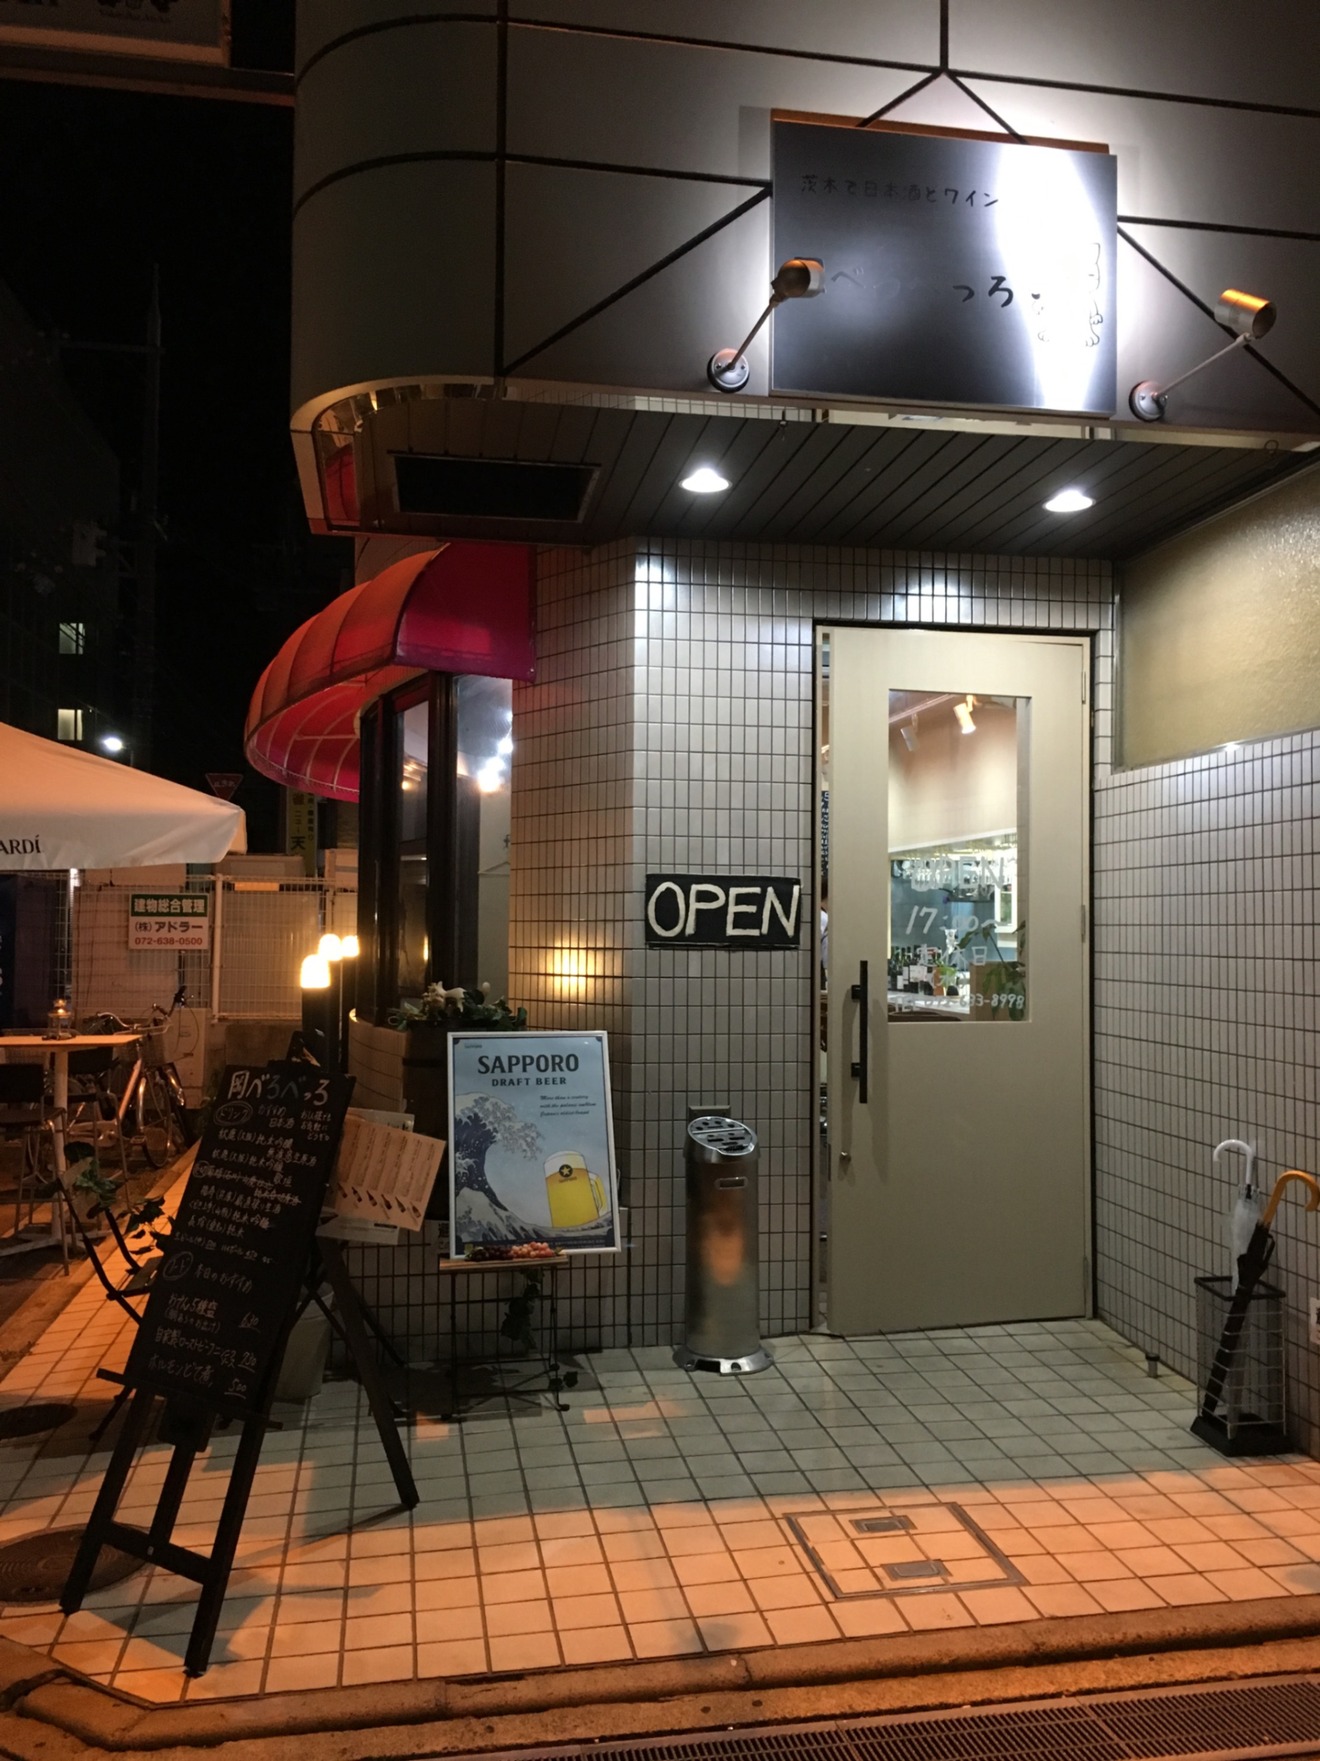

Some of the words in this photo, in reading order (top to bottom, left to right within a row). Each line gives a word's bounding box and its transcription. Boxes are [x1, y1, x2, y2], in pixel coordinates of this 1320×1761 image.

[134, 898, 205, 913] 建物総合管理
[647, 881, 801, 938] OPEN
[135, 937, 203, 945] 072-638-0500
[478, 1054, 579, 1074] SAPPORO
[492, 1078, 530, 1087] DRAFT
[536, 1077, 567, 1085] BEER
